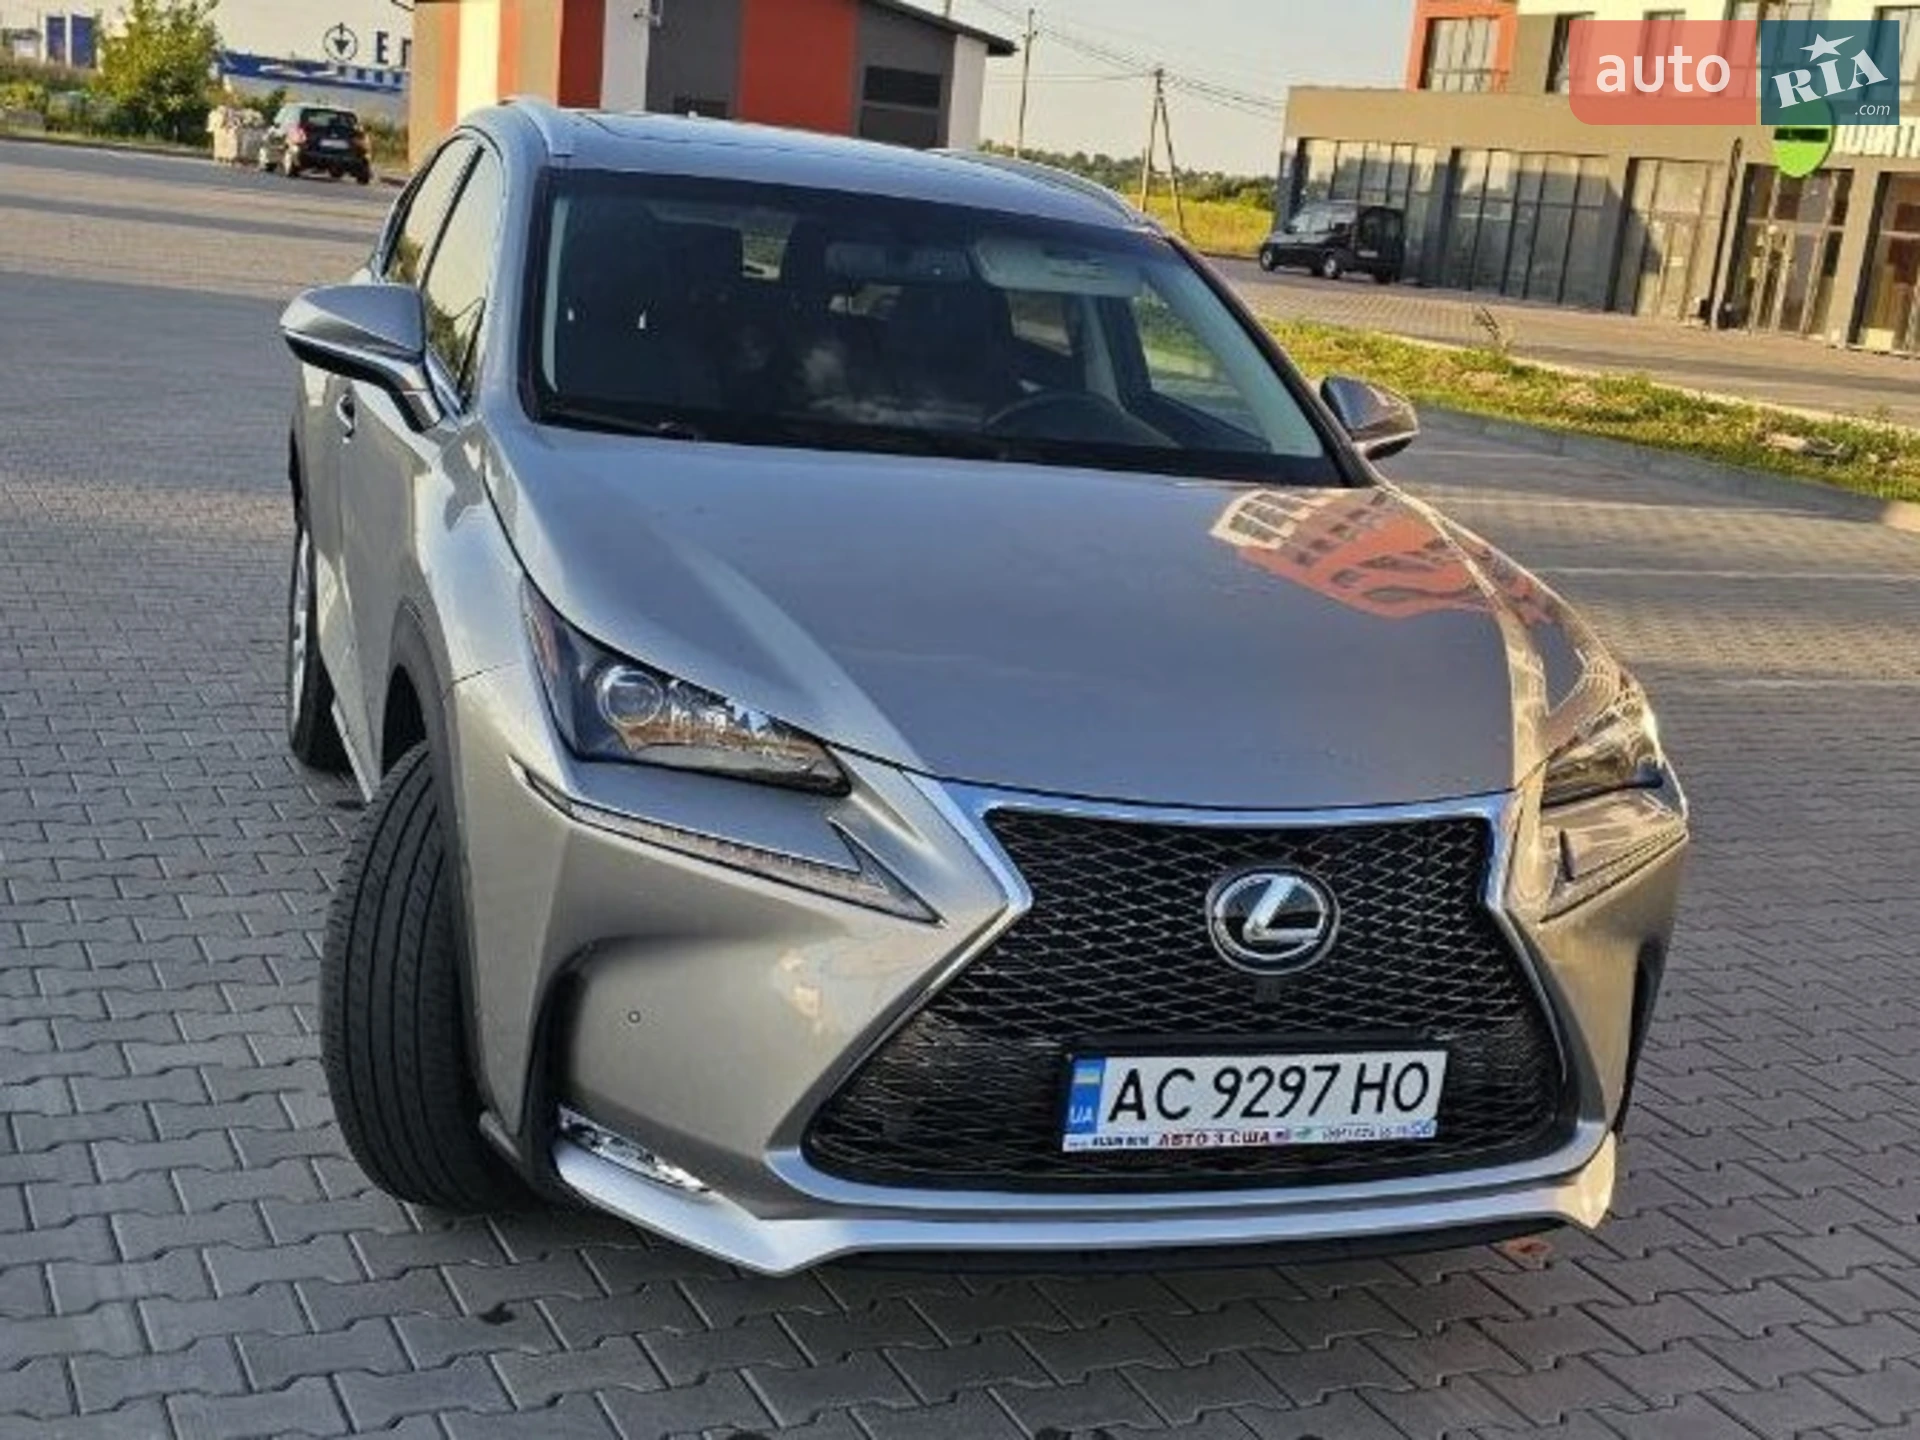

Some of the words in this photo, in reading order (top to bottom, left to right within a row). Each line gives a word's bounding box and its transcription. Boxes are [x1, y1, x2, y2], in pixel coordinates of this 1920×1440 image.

[1108, 1068, 1195, 1122] AC
[1212, 1063, 1341, 1118] 9297
[1351, 1062, 1430, 1114] HO
[1069, 1107, 1093, 1125] UA
